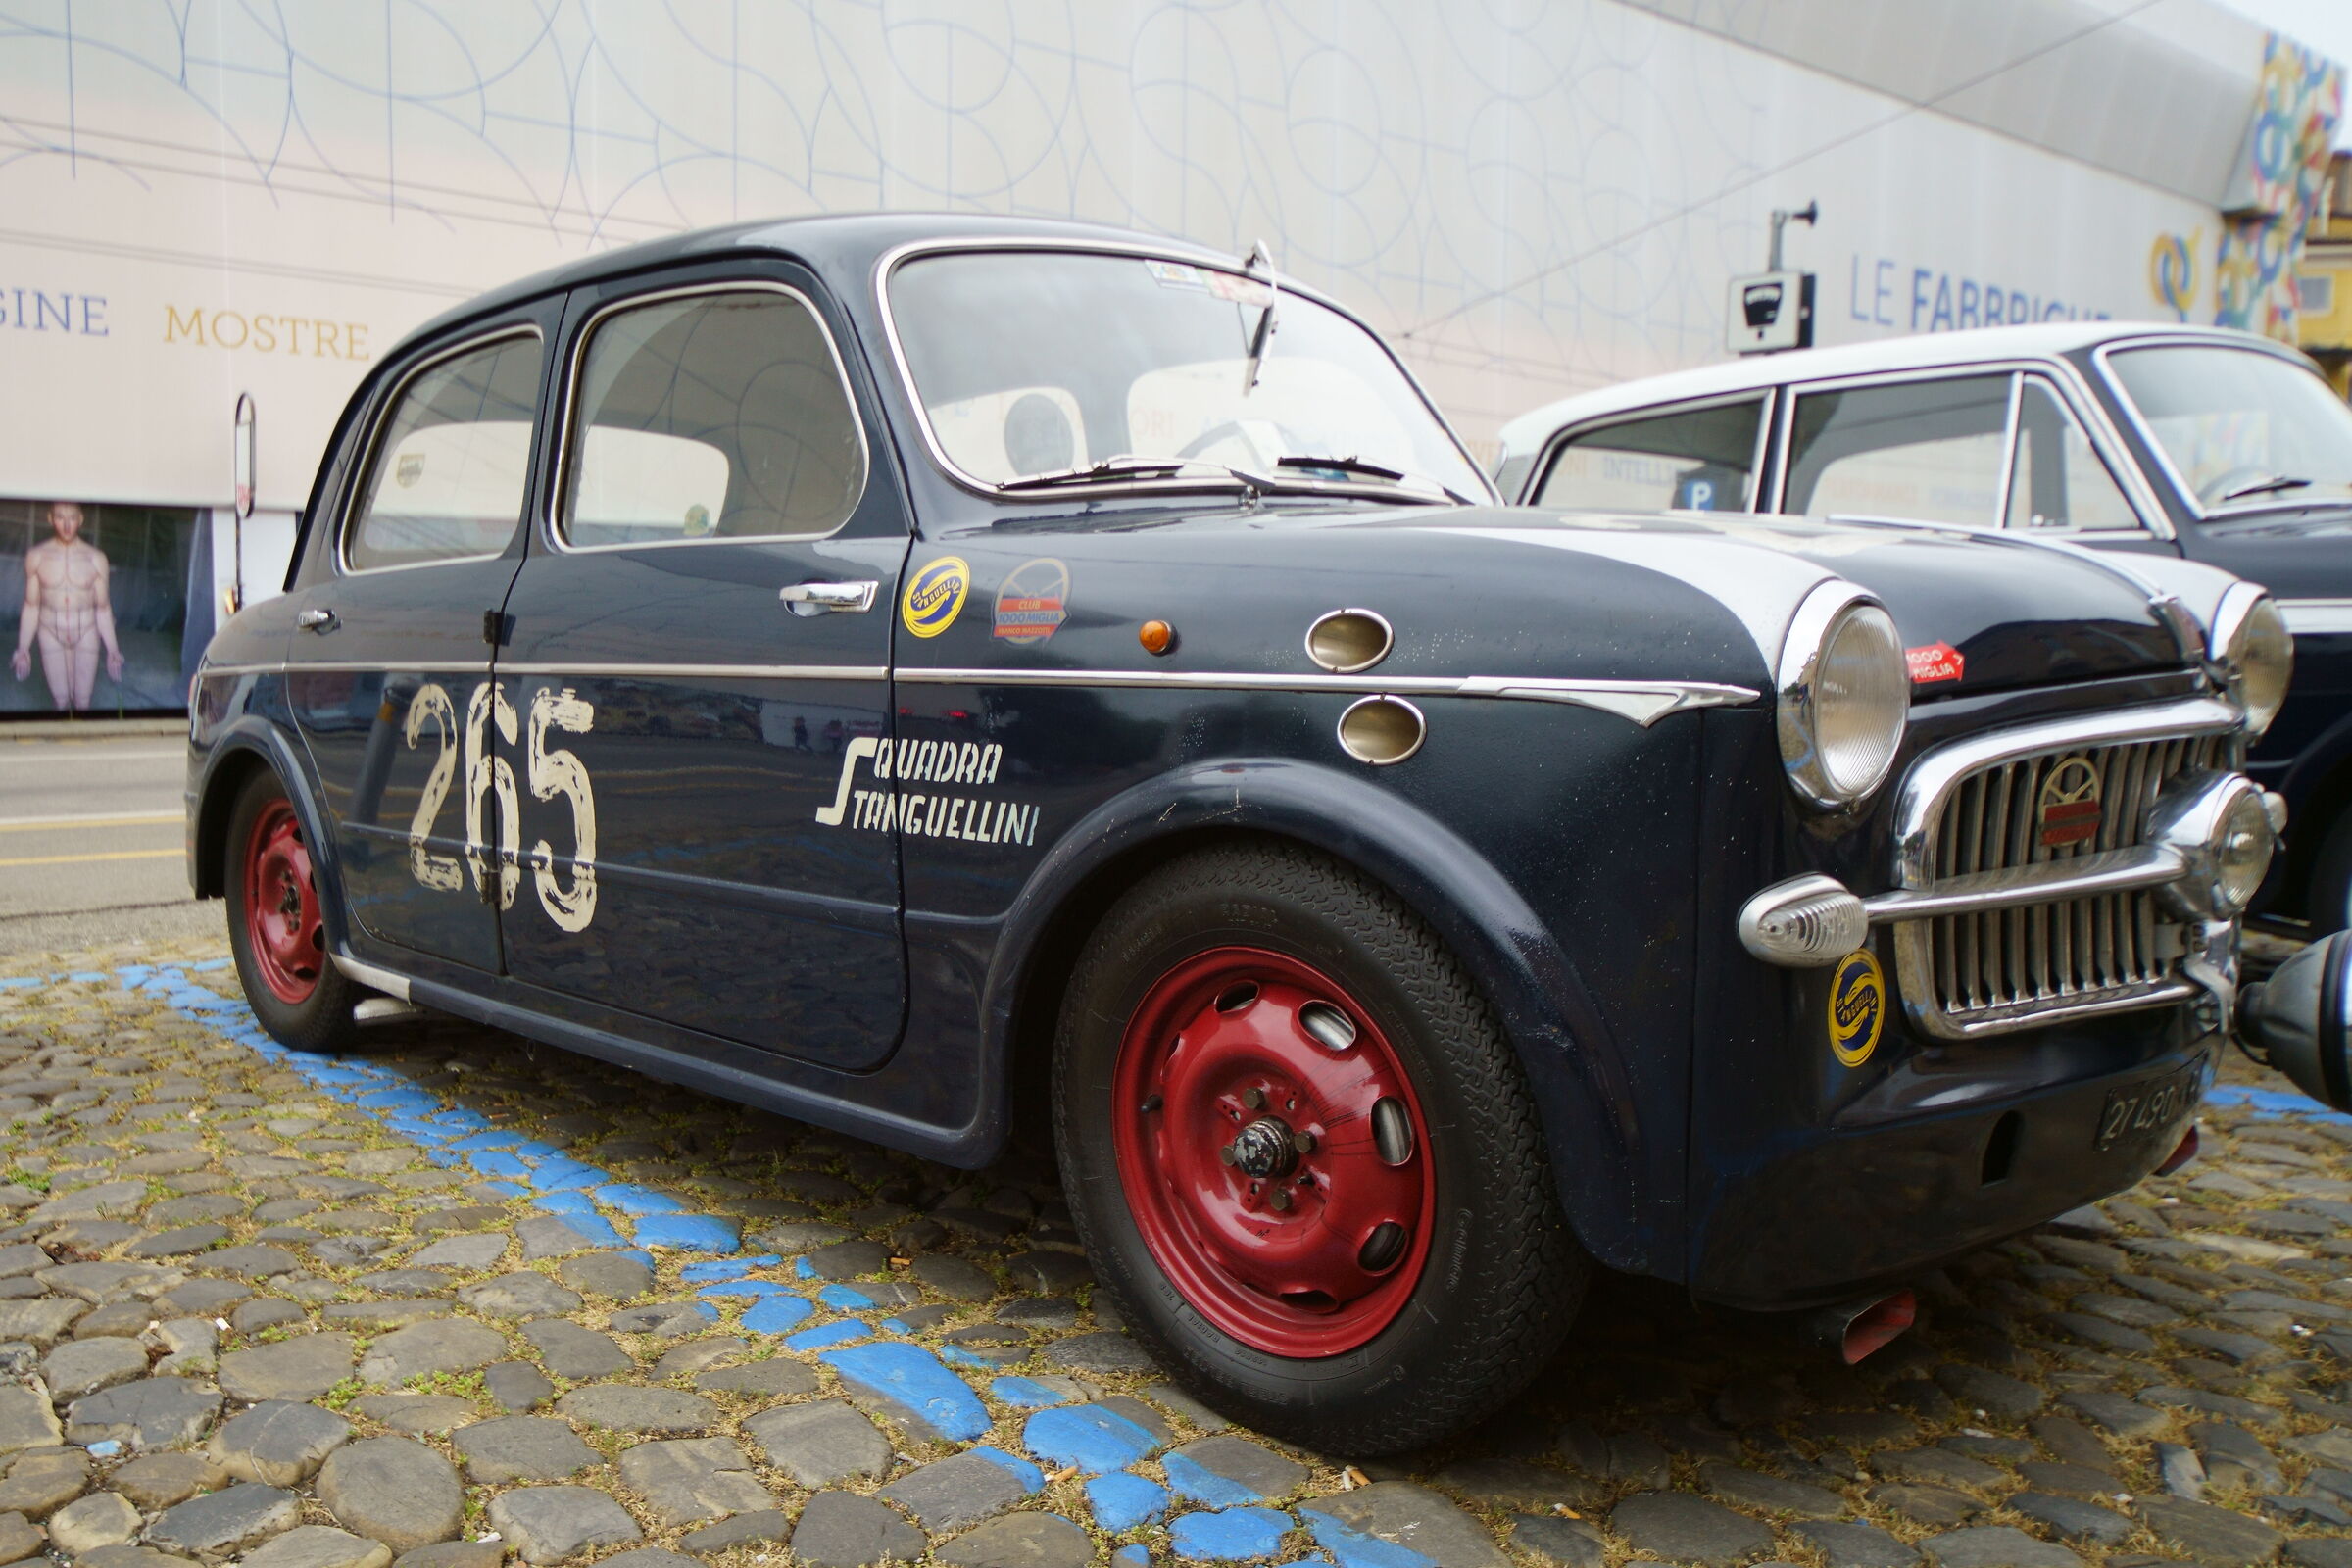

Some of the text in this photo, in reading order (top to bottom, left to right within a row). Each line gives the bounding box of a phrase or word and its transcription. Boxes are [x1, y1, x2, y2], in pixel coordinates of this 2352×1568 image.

[0, 287, 371, 362] INE MOSTRE
[1850, 254, 1895, 326] LE
[1019, 599, 1042, 610] CLUB
[406, 683, 597, 932] 265
